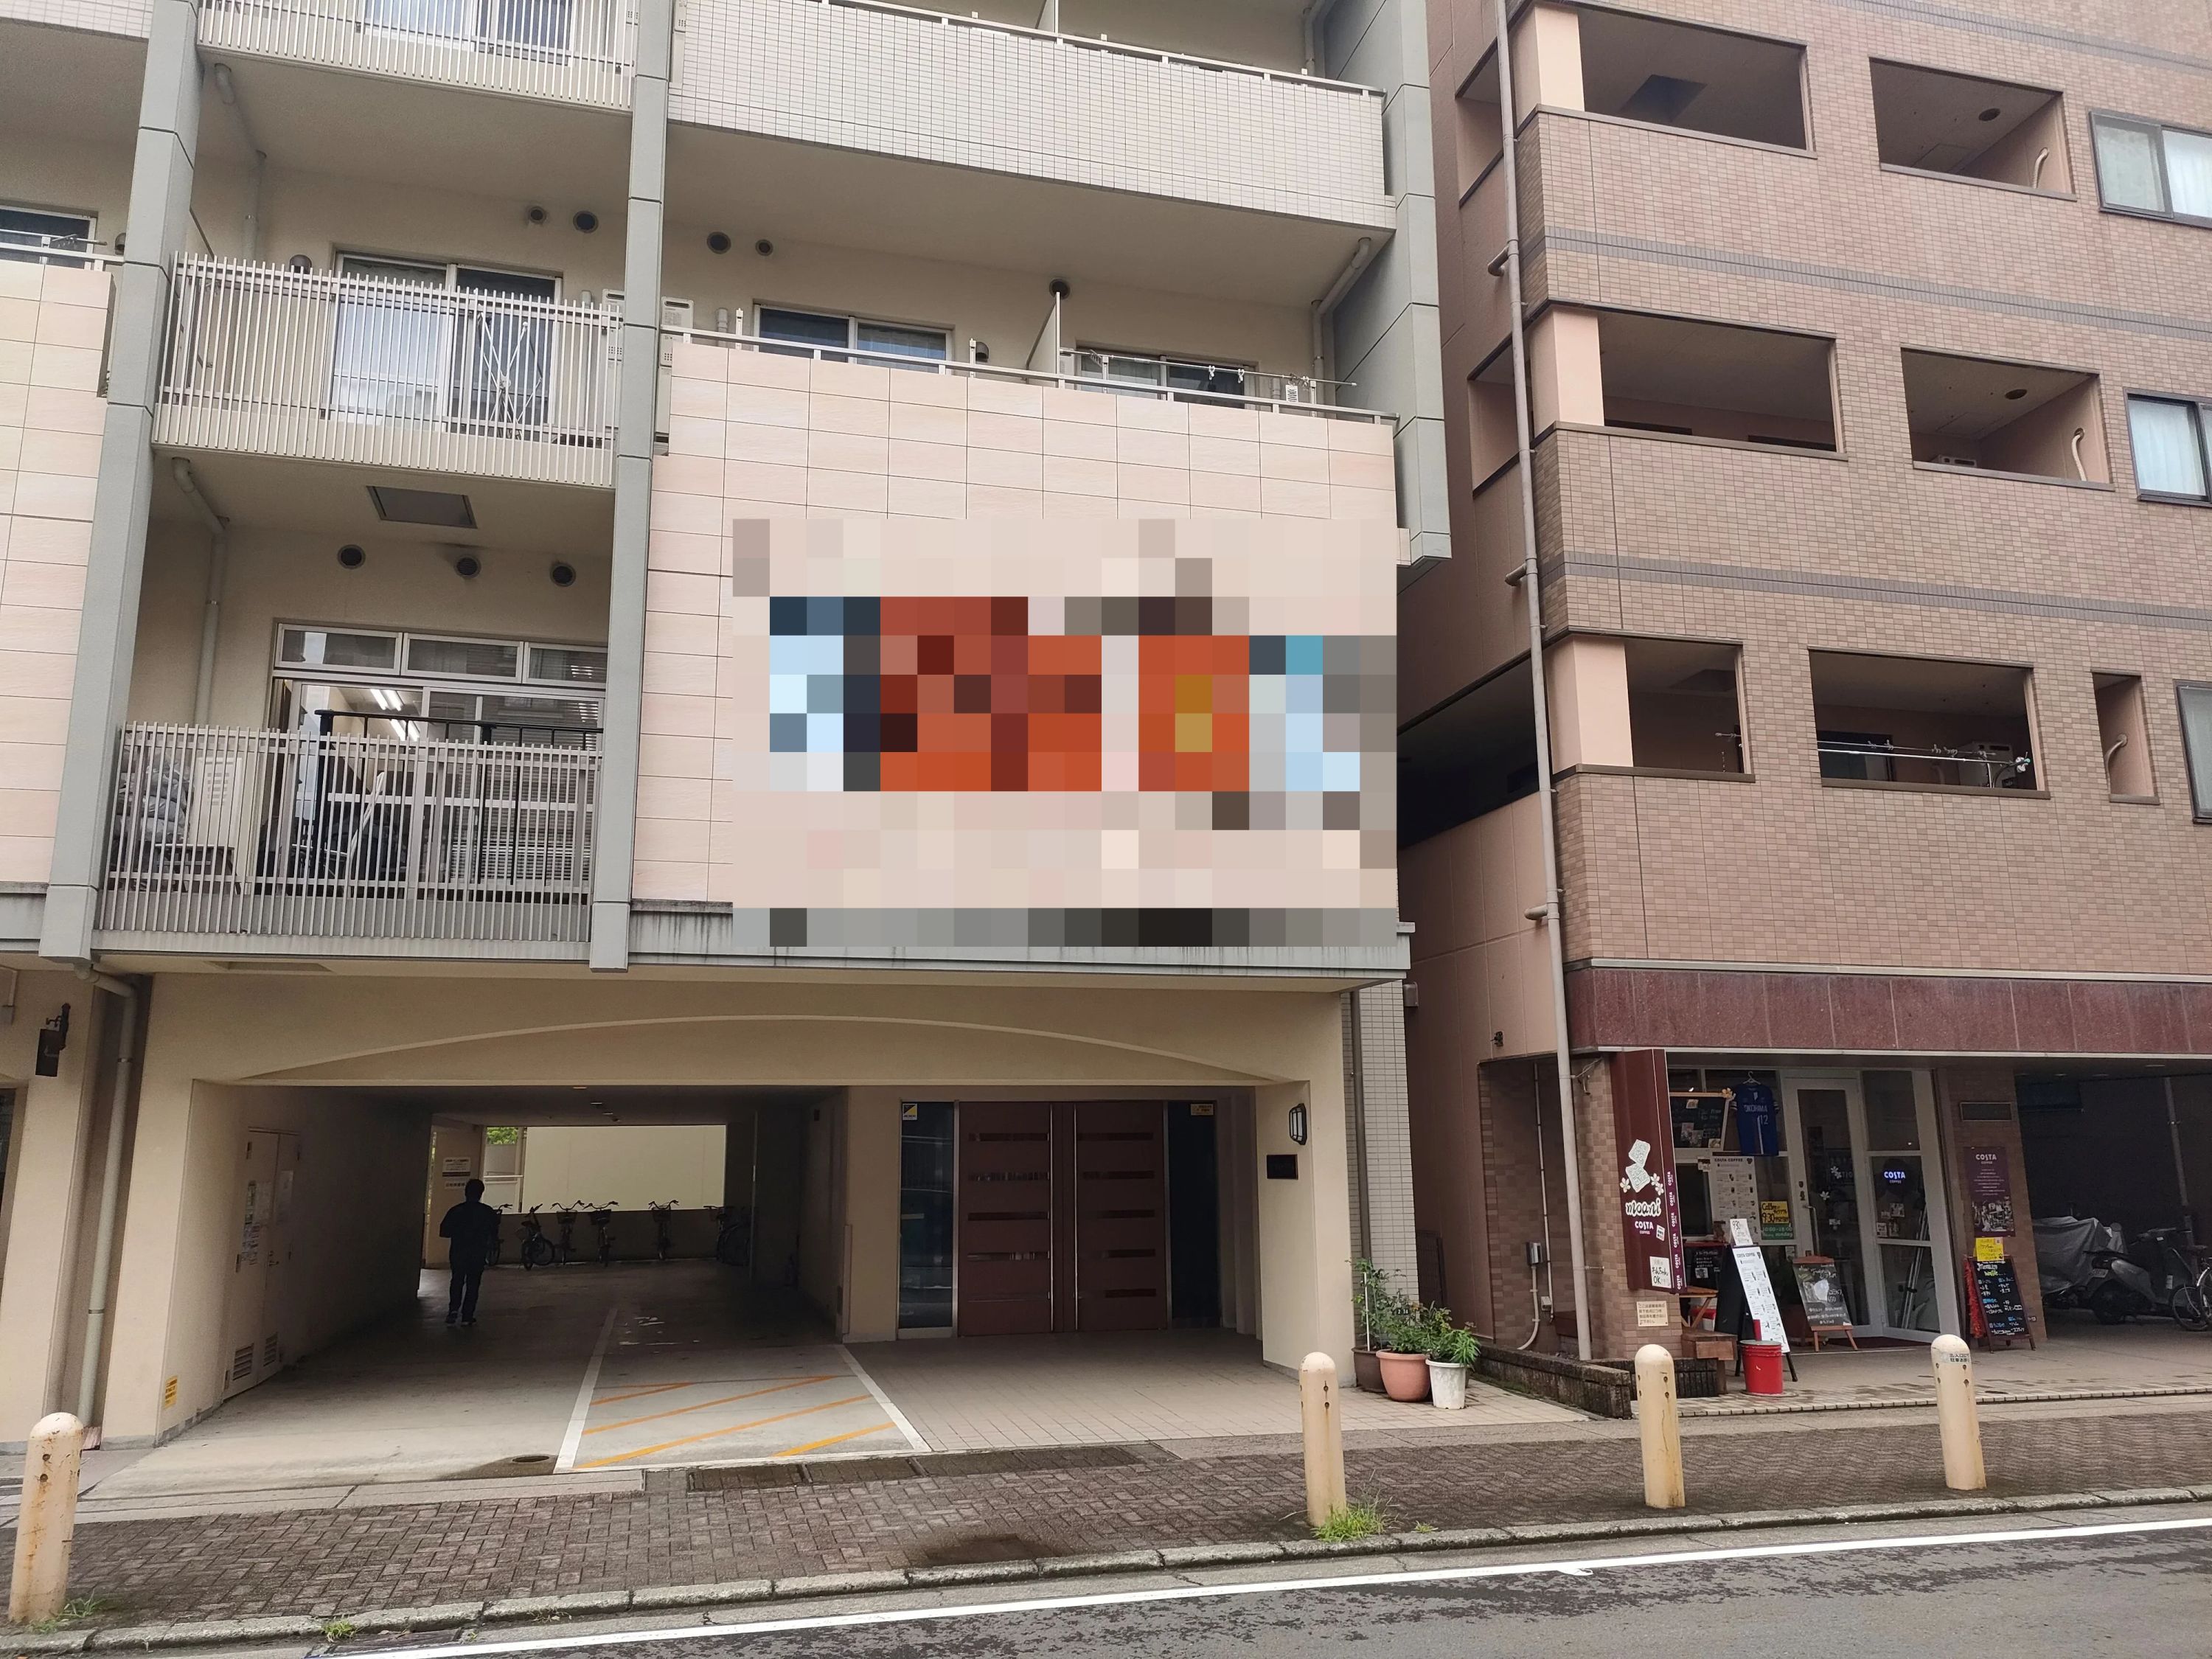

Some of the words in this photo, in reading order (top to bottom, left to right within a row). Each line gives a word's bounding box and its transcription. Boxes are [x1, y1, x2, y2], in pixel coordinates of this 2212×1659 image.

[1760, 1114, 1769, 1125] 12
[1883, 1171, 1906, 1180] COSTA
[1625, 1197, 1662, 1217] moani
[1635, 1221, 1654, 1230] COSTA
[1653, 1276, 1661, 1284] OK
